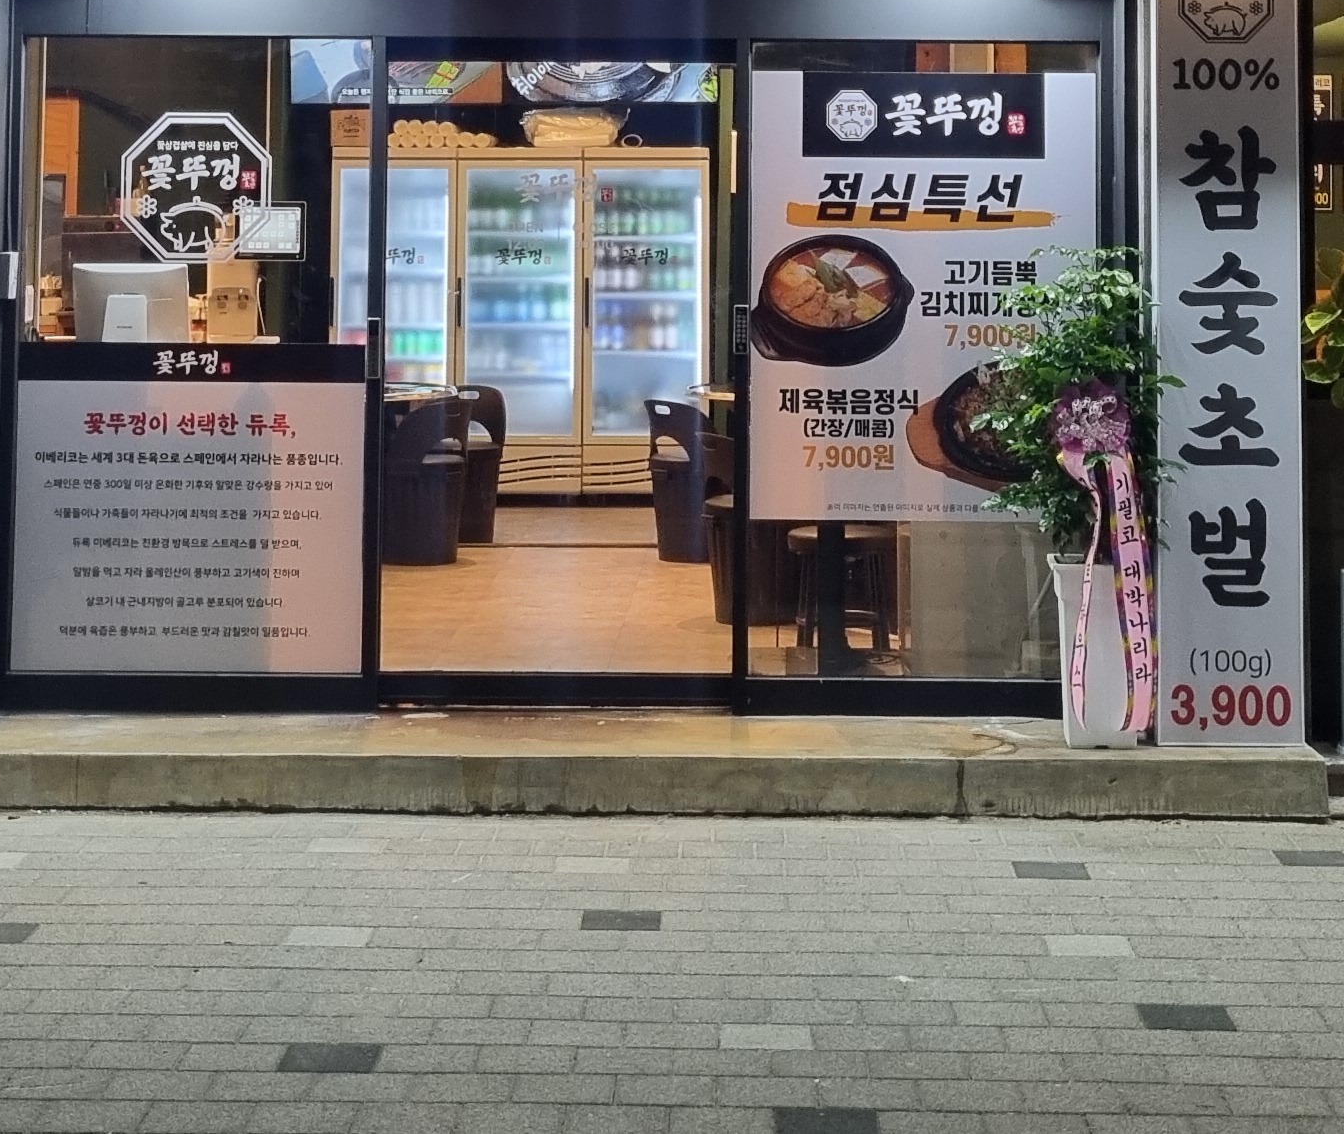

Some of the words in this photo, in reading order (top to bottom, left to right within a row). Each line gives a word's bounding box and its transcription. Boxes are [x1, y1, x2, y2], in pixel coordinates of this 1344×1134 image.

[1172, 57, 1280, 92] 100%
[885, 92, 1003, 136] 꽃뚜껑
[141, 153, 241, 191] 꽃뚜껑
[816, 172, 1024, 223] 점심특선
[386, 247, 417, 265] 뚜껑
[494, 247, 543, 266] 꽃뚜껑
[621, 247, 669, 266] 꽃뚜껑
[943, 260, 1038, 286] 고기듬뿍
[152, 349, 220, 376] 꽃뚜껑
[1178, 124, 1280, 608] 참숯초벌
[778, 387, 919, 416] 제육볶음정식
[83, 411, 168, 436] 꽃뚜껑이
[176, 411, 240, 437] 선택한
[244, 413, 296, 439] 듀록,
[803, 417, 895, 439] (간장/매콤)
[803, 443, 895, 472] 7,900원
[1116, 471, 1140, 546] 기필코
[1123, 560, 1153, 685] 대박나리라
[1189, 647, 1272, 678] (100g)
[1170, 684, 1292, 732] 3,900
